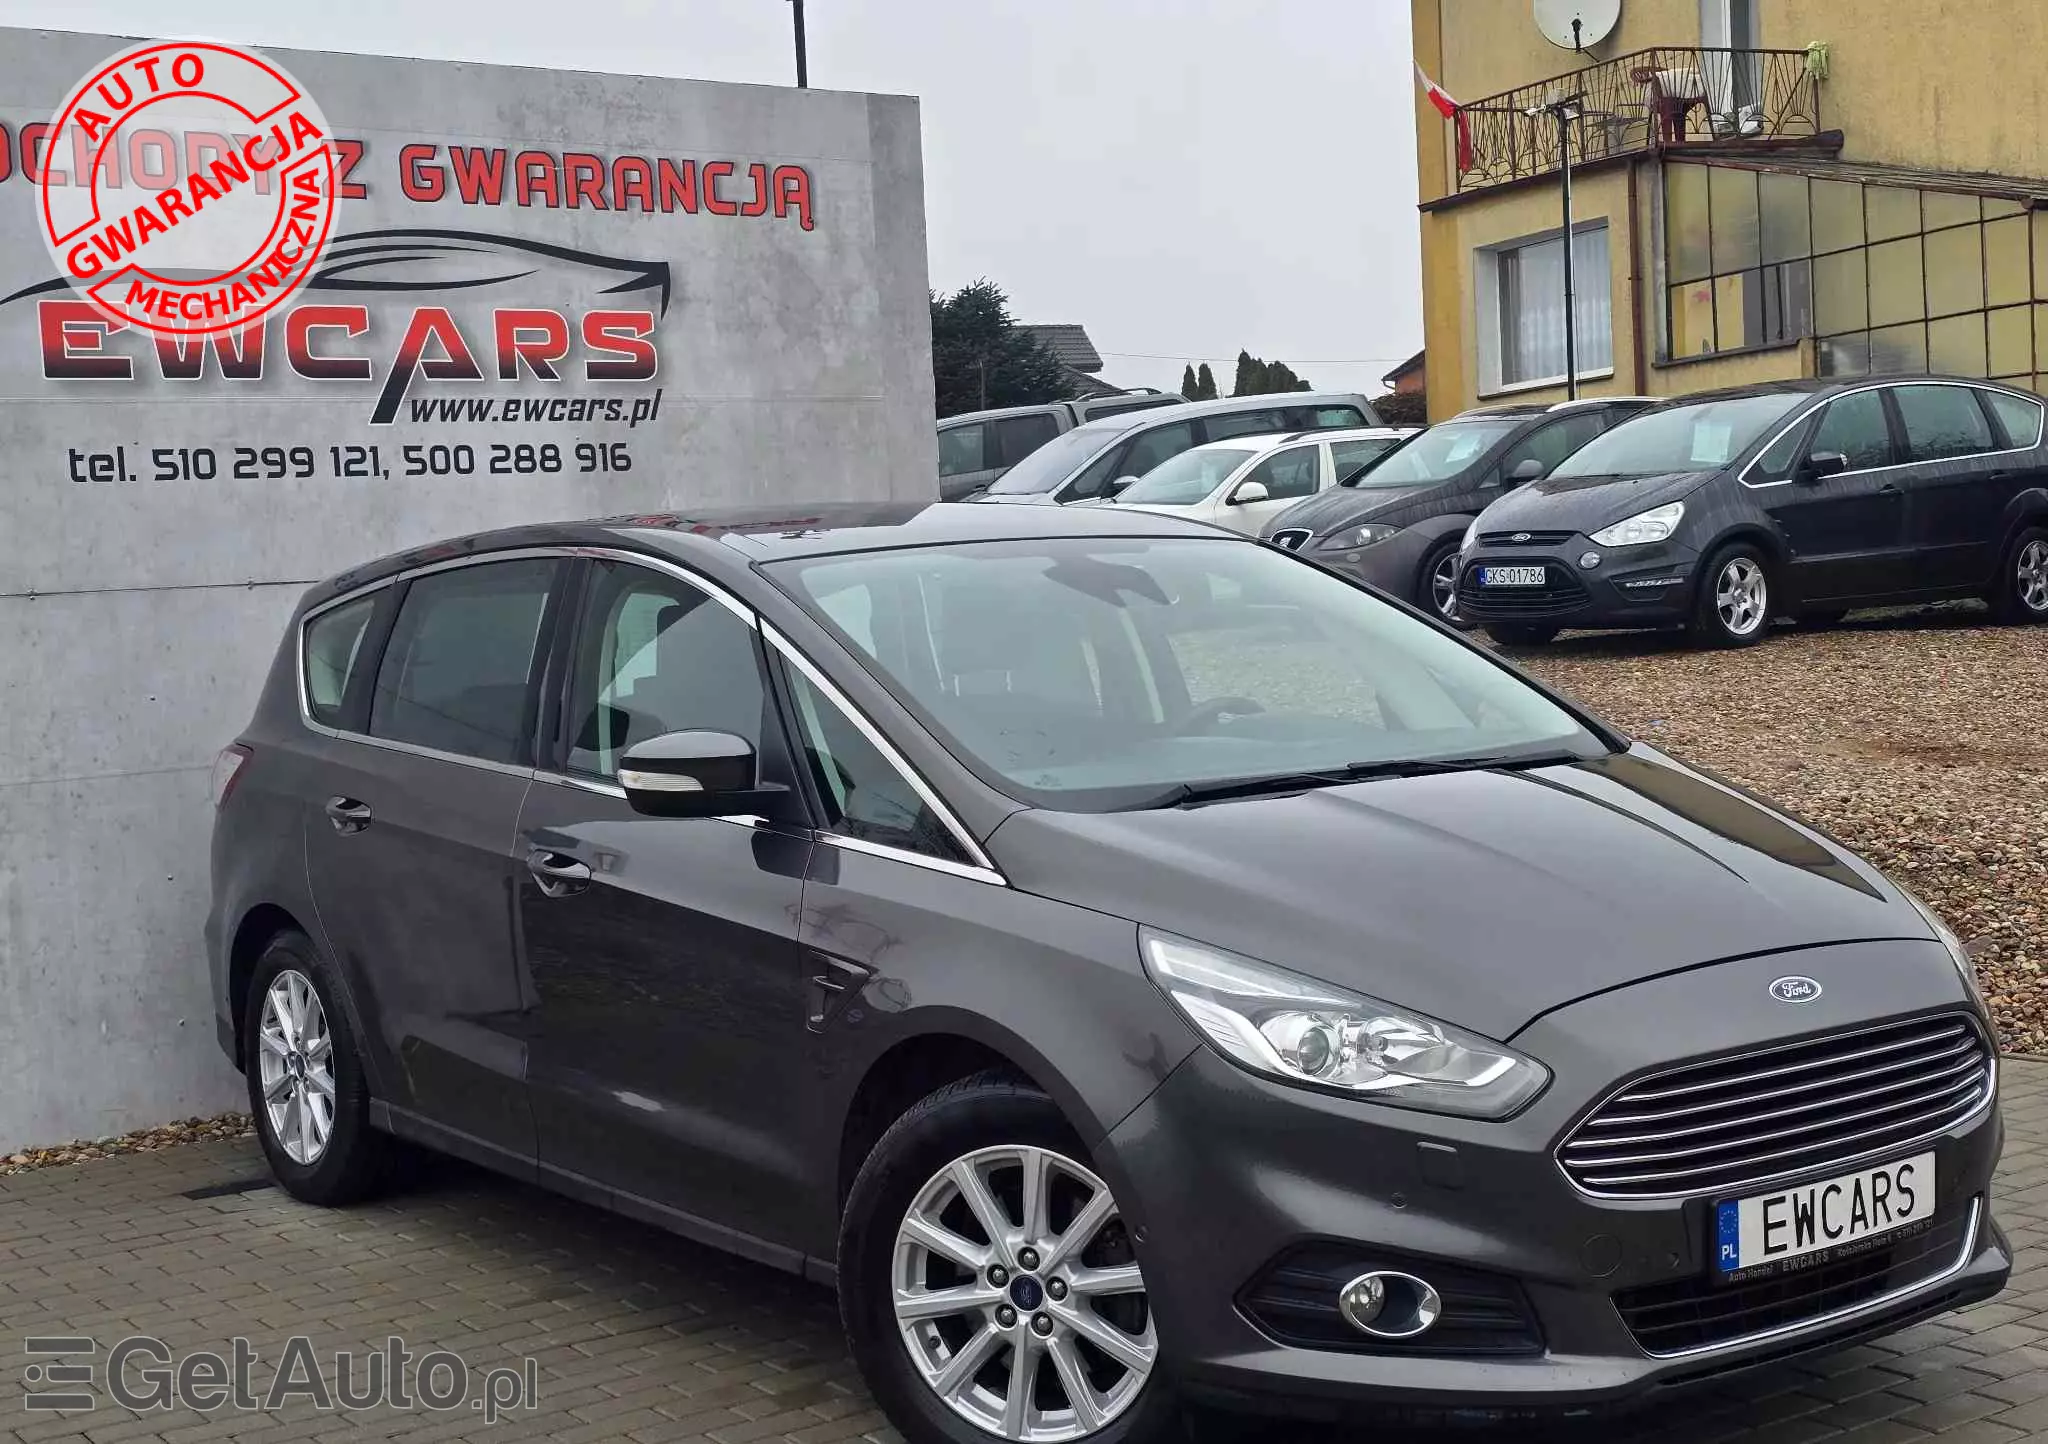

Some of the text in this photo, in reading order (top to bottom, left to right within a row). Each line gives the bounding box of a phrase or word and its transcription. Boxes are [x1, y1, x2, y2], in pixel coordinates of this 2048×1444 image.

[0, 122, 814, 231] CHODY Z GWARANCJĄ
[38, 300, 657, 425] EWCARS
[411, 389, 662, 428] www.ewcars.pl
[68, 443, 632, 483] tel. 510 299 121, 500 288 916
[1486, 567, 1544, 584] GKS 01786
[1782, 982, 1812, 998] Ford
[1763, 1164, 1915, 1256] EWCARS
[1721, 1244, 1737, 1261] PL
[1782, 1251, 1830, 1272] EWCARS
